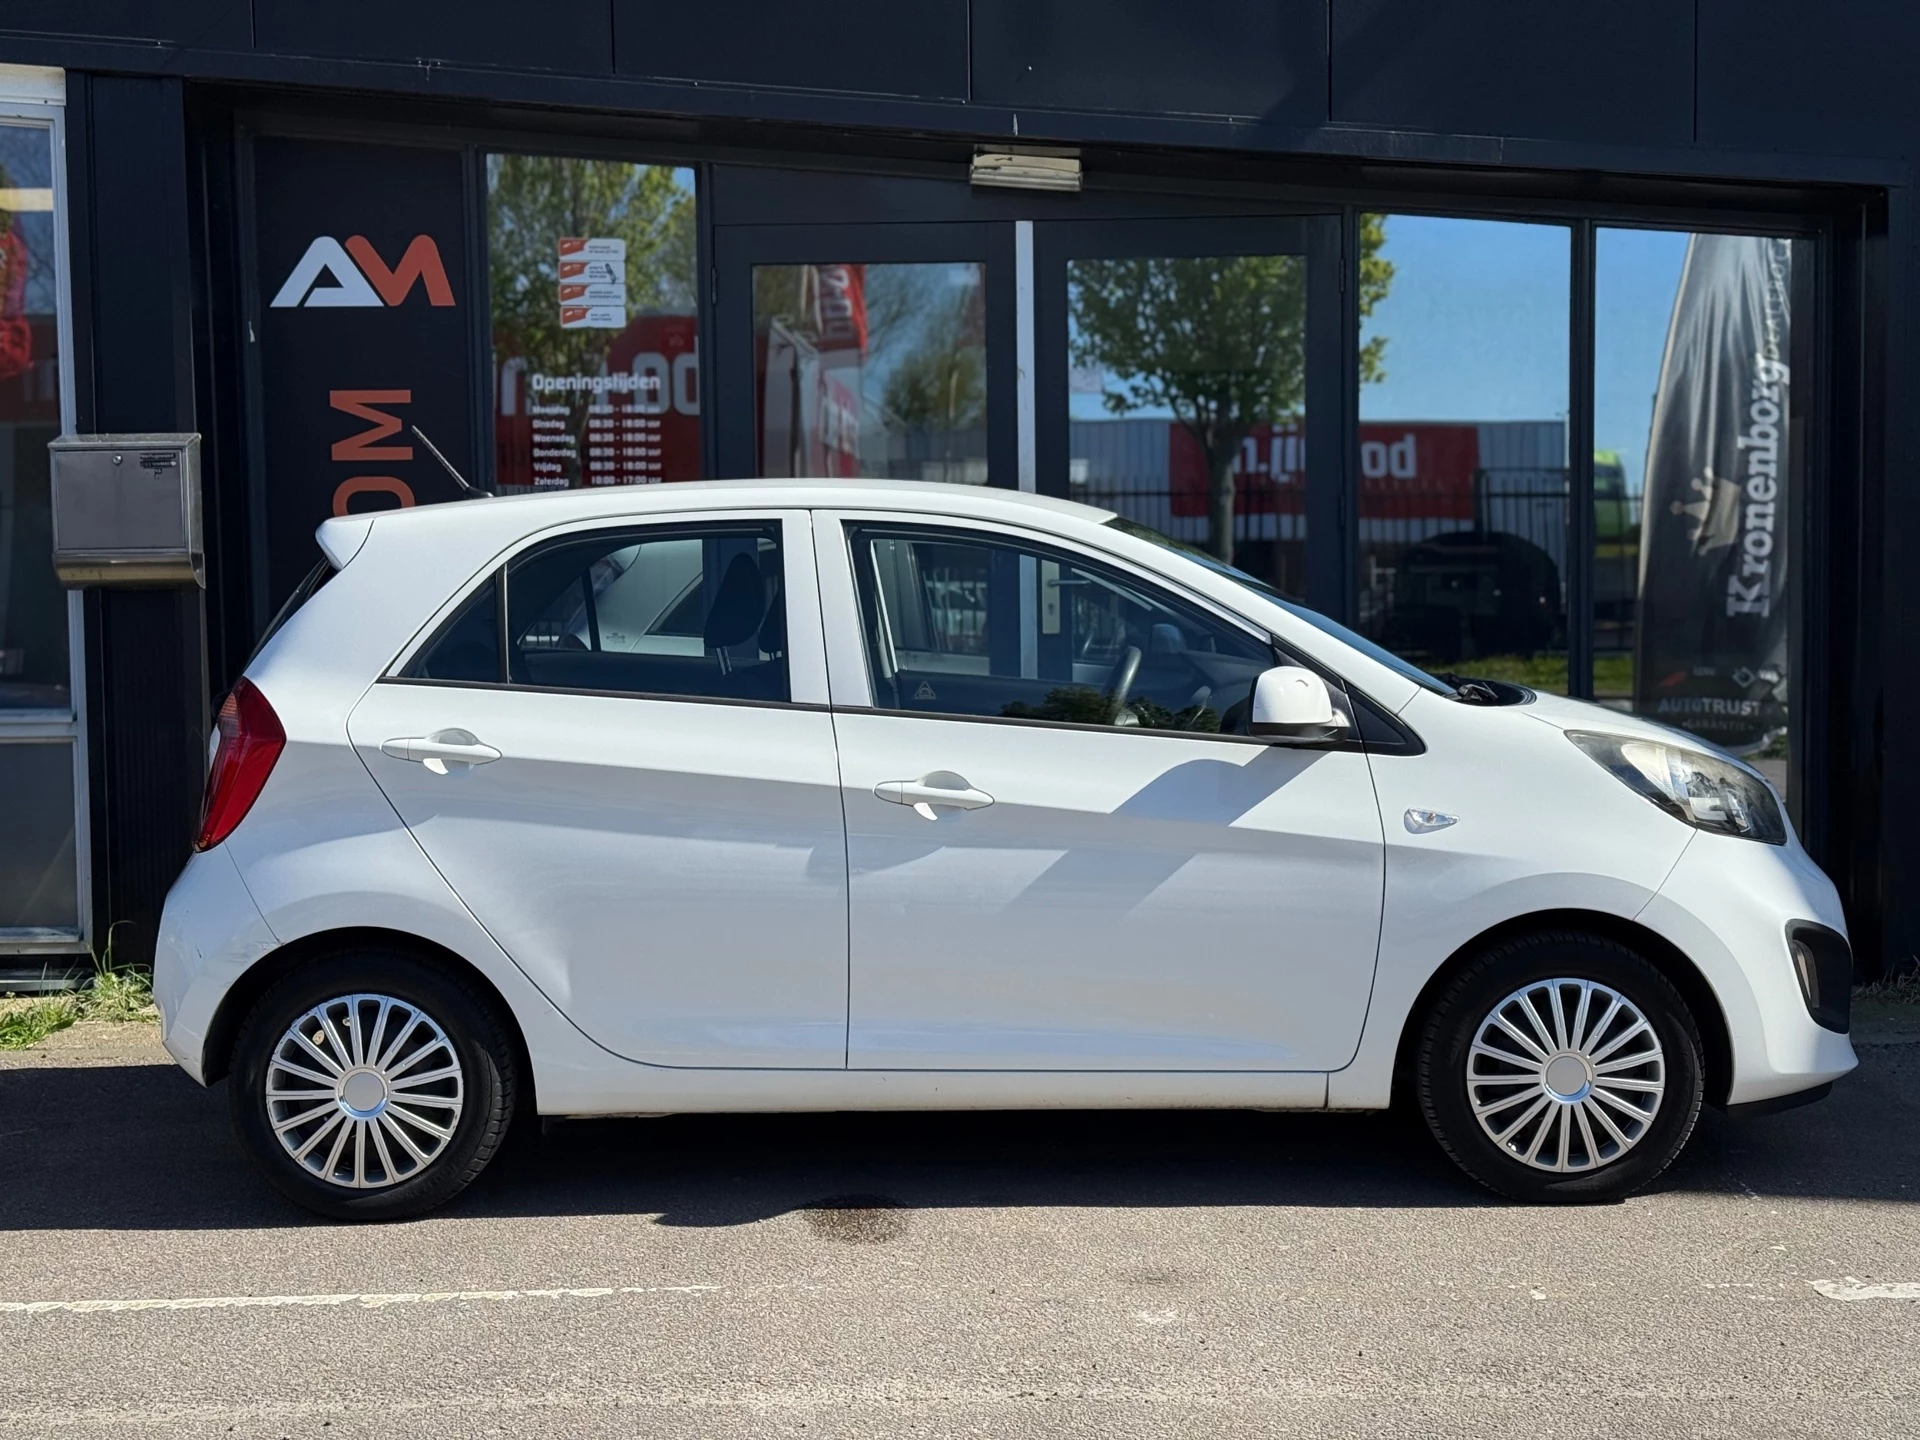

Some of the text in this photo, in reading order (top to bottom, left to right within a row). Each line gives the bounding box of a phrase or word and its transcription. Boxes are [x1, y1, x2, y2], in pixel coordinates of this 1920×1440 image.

[269, 234, 456, 308] AM
[532, 372, 660, 394] Openingstijden
[532, 420, 565, 430] Dinsdag
[532, 434, 575, 444] Woensdag
[532, 448, 577, 458] Donderdag
[533, 462, 562, 472] Vrijdag
[534, 477, 570, 487] Zaterdag
[1726, 352, 1790, 618] Kronenborg
[1658, 697, 1762, 716] AUTOTRUST
